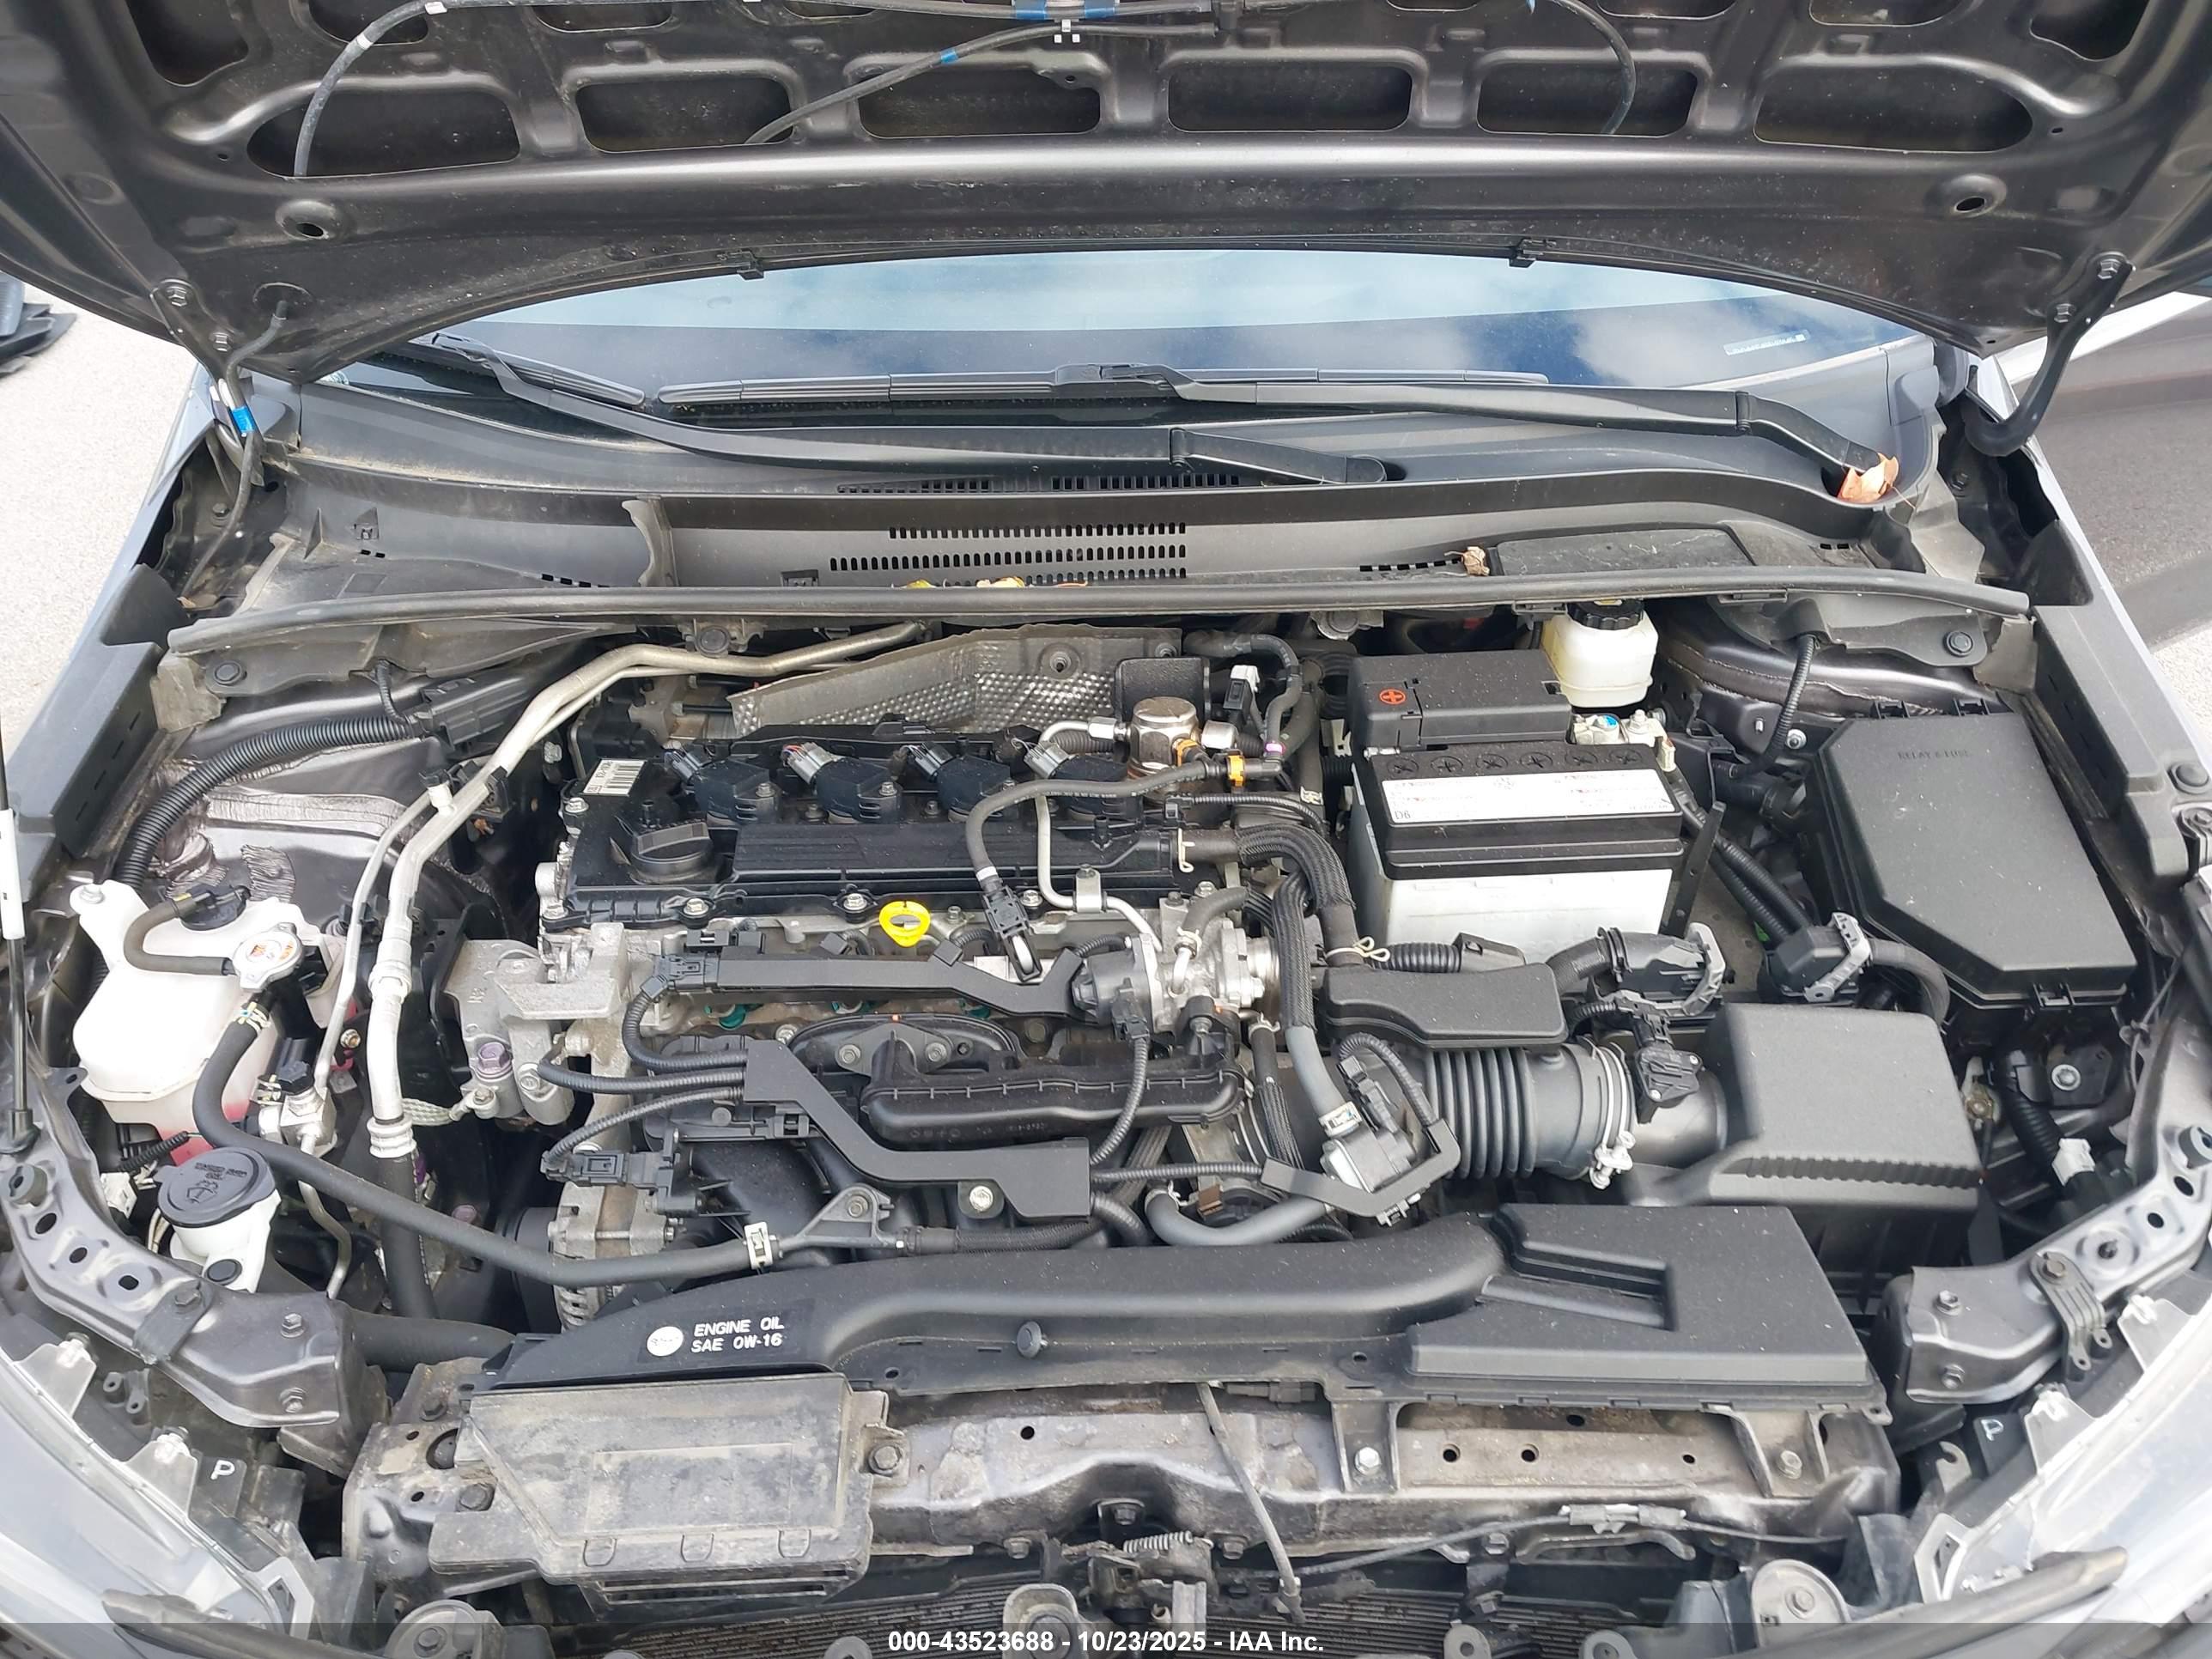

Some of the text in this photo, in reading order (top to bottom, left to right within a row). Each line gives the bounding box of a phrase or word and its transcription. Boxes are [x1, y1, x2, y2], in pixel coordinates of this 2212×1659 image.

[694, 1316, 785, 1337] ENGINE OIL
[690, 1332, 784, 1353] SAE 0W-16
[1980, 1419, 2004, 1442] P
[210, 1459, 235, 1480] P
